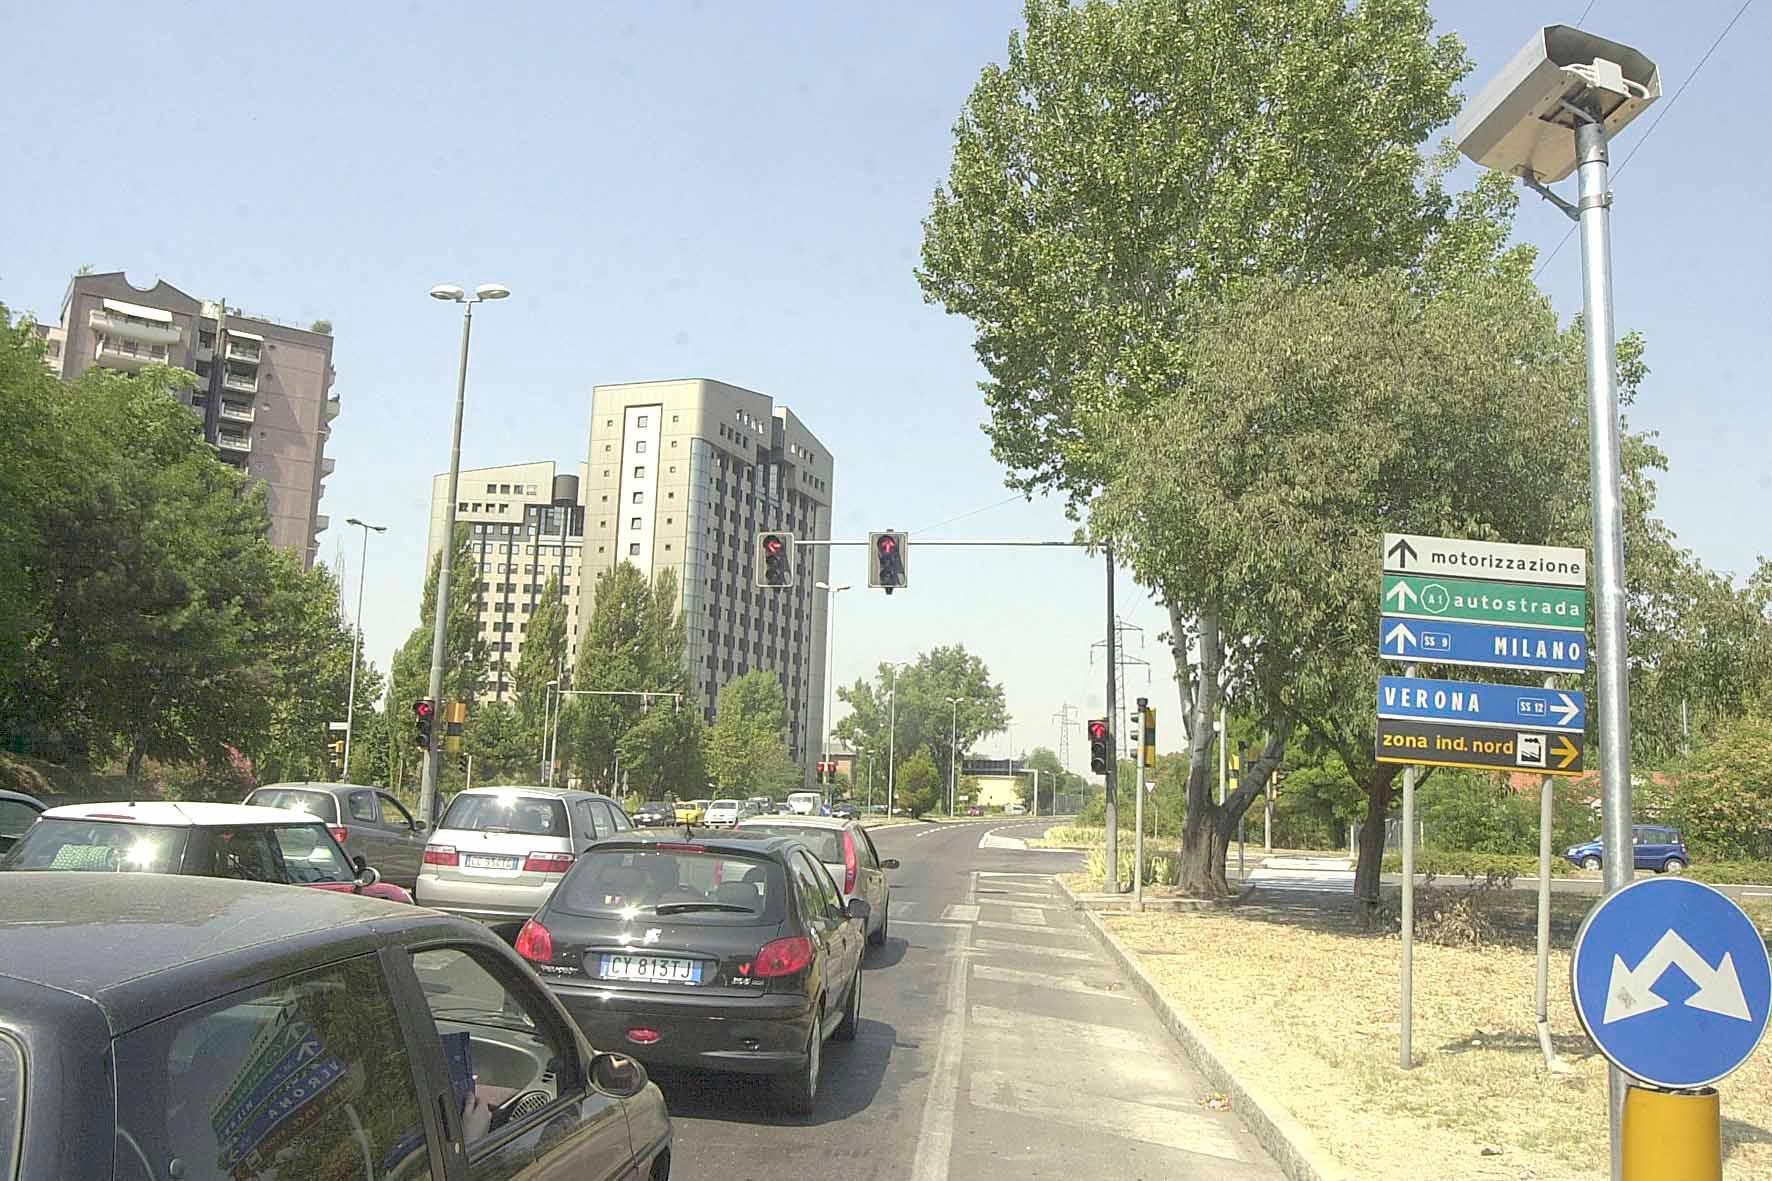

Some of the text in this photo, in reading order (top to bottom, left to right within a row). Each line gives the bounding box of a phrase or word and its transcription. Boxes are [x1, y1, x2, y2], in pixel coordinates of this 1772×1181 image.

[1431, 552, 1580, 574] motorizzazione
[1454, 595, 1580, 616] autostrada
[1424, 636, 1580, 661] SS 9 MILANO
[1384, 687, 1544, 713] VERONA SS 12
[1383, 734, 1514, 755] zona ind. nord
